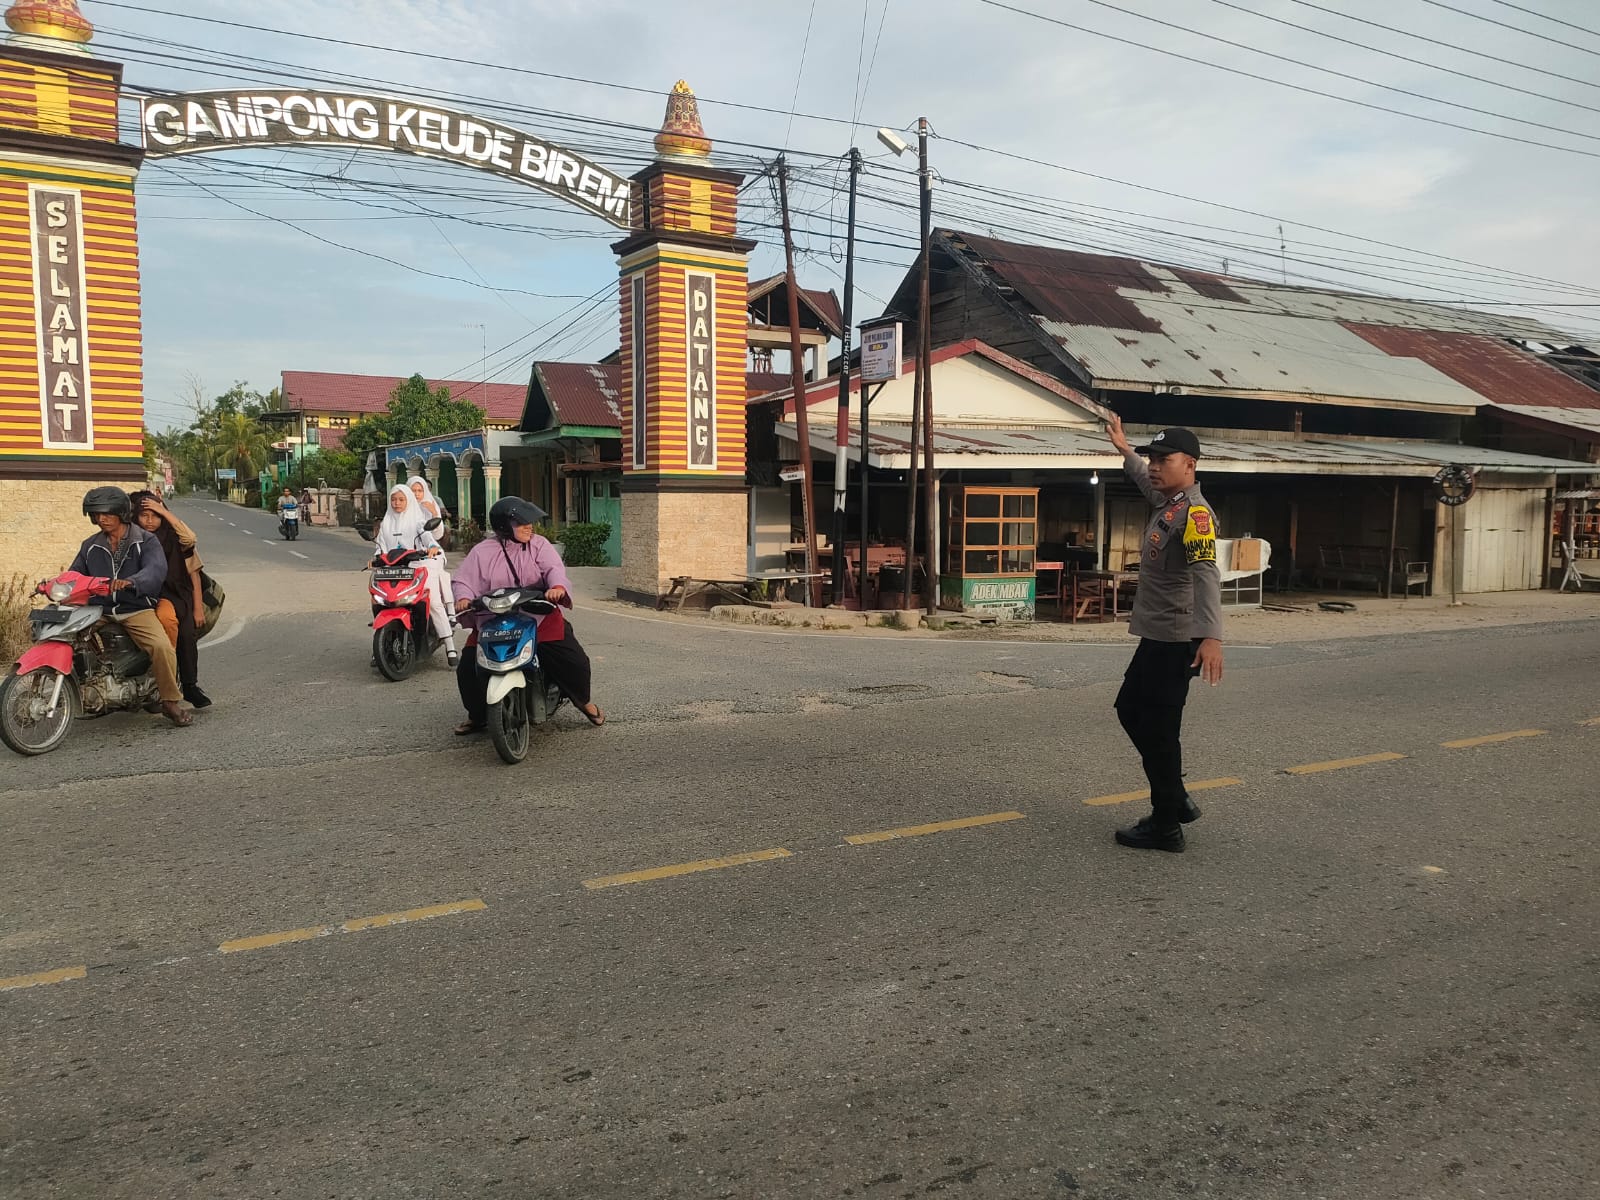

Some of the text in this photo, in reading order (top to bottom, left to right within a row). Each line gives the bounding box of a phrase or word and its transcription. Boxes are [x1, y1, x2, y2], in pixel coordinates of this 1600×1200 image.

[145, 94, 631, 219] GAMPONG KEUDE BIREM
[46, 200, 80, 432] SELAMAT
[692, 289, 709, 447] DATANG
[971, 582, 1028, 600] ADEK MBAK
